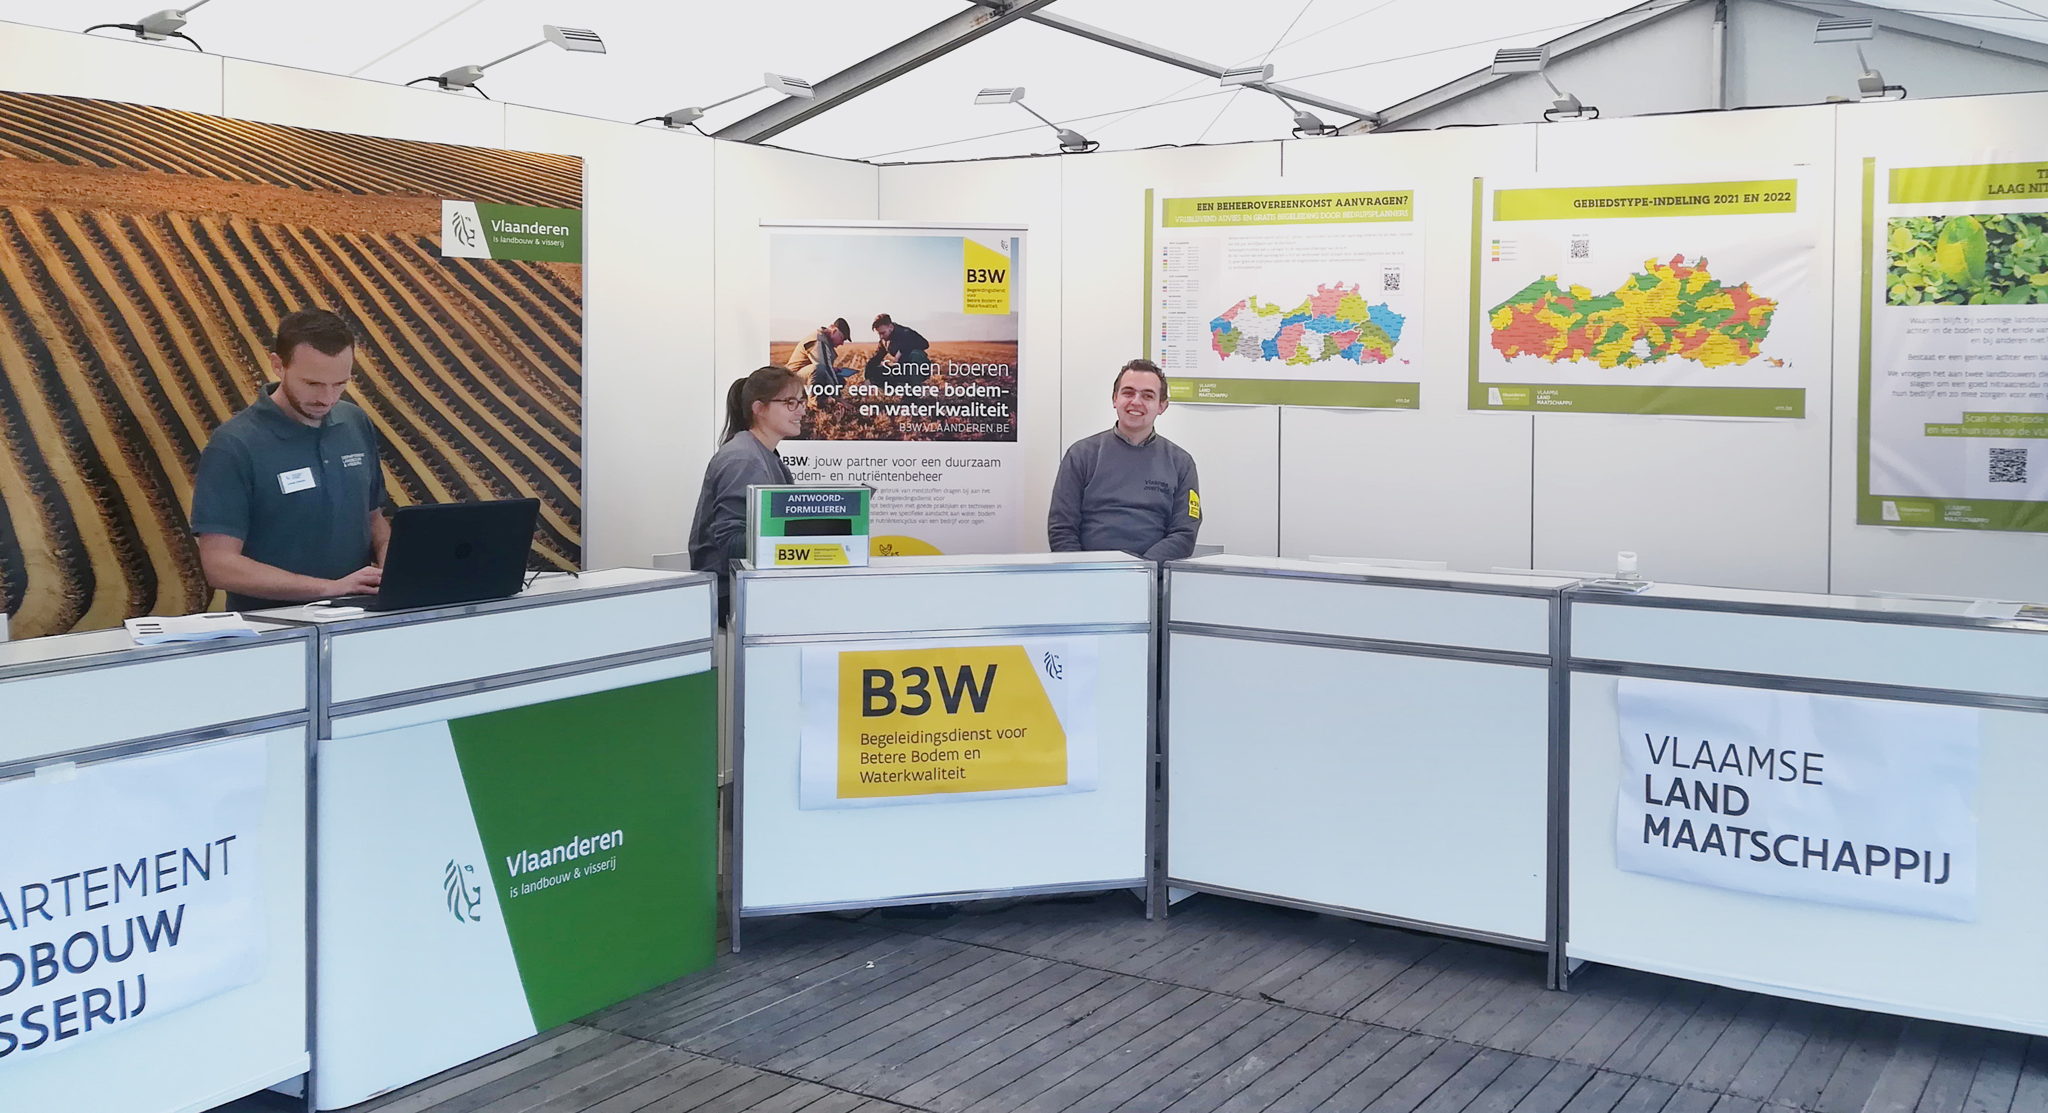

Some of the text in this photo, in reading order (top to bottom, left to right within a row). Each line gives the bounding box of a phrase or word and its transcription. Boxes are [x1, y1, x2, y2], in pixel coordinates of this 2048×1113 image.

[1988, 184, 2025, 195] LAAG
[1197, 196, 1409, 211] EEN BEHEEROVEREENKOMST AANVRAGEN?
[1574, 192, 1791, 208] GEBIEDSTYPE-INDELING 2021 EN 2022
[491, 219, 569, 237] Vlaanderen
[500, 236, 533, 245] landbouw
[541, 239, 565, 248] visserij
[967, 269, 1006, 283] B3W
[882, 360, 1009, 377] Samen boeren
[804, 382, 1010, 397] voor een betere bodem-
[859, 402, 1010, 418] en waterkwaliteit
[899, 423, 1010, 433] B3W.VLAANDEREN.BE
[813, 456, 843, 469] jouw
[847, 457, 888, 469] partner
[892, 458, 917, 468] voor
[921, 458, 941, 468] een
[945, 456, 1001, 468] duurzaam
[792, 470, 826, 481] odem-
[848, 471, 943, 482] nutriëntenbeheer
[788, 494, 845, 503] ANTWOORD-
[785, 506, 847, 514] FORMULIEREN
[778, 549, 811, 561] B3W
[862, 664, 998, 717] B3W
[861, 727, 1027, 746] Begeleidingsdienst voor
[860, 747, 981, 765] Betere Bodem en
[1645, 733, 1824, 785] VLAAMSE
[860, 766, 966, 783] Waterkwaliteit
[1645, 774, 1750, 816] LAND
[506, 829, 624, 877] Vlaanderen
[1643, 813, 1950, 885] MAATSCHAPPIJ
[510, 856, 617, 898] is landbouw & visserij
